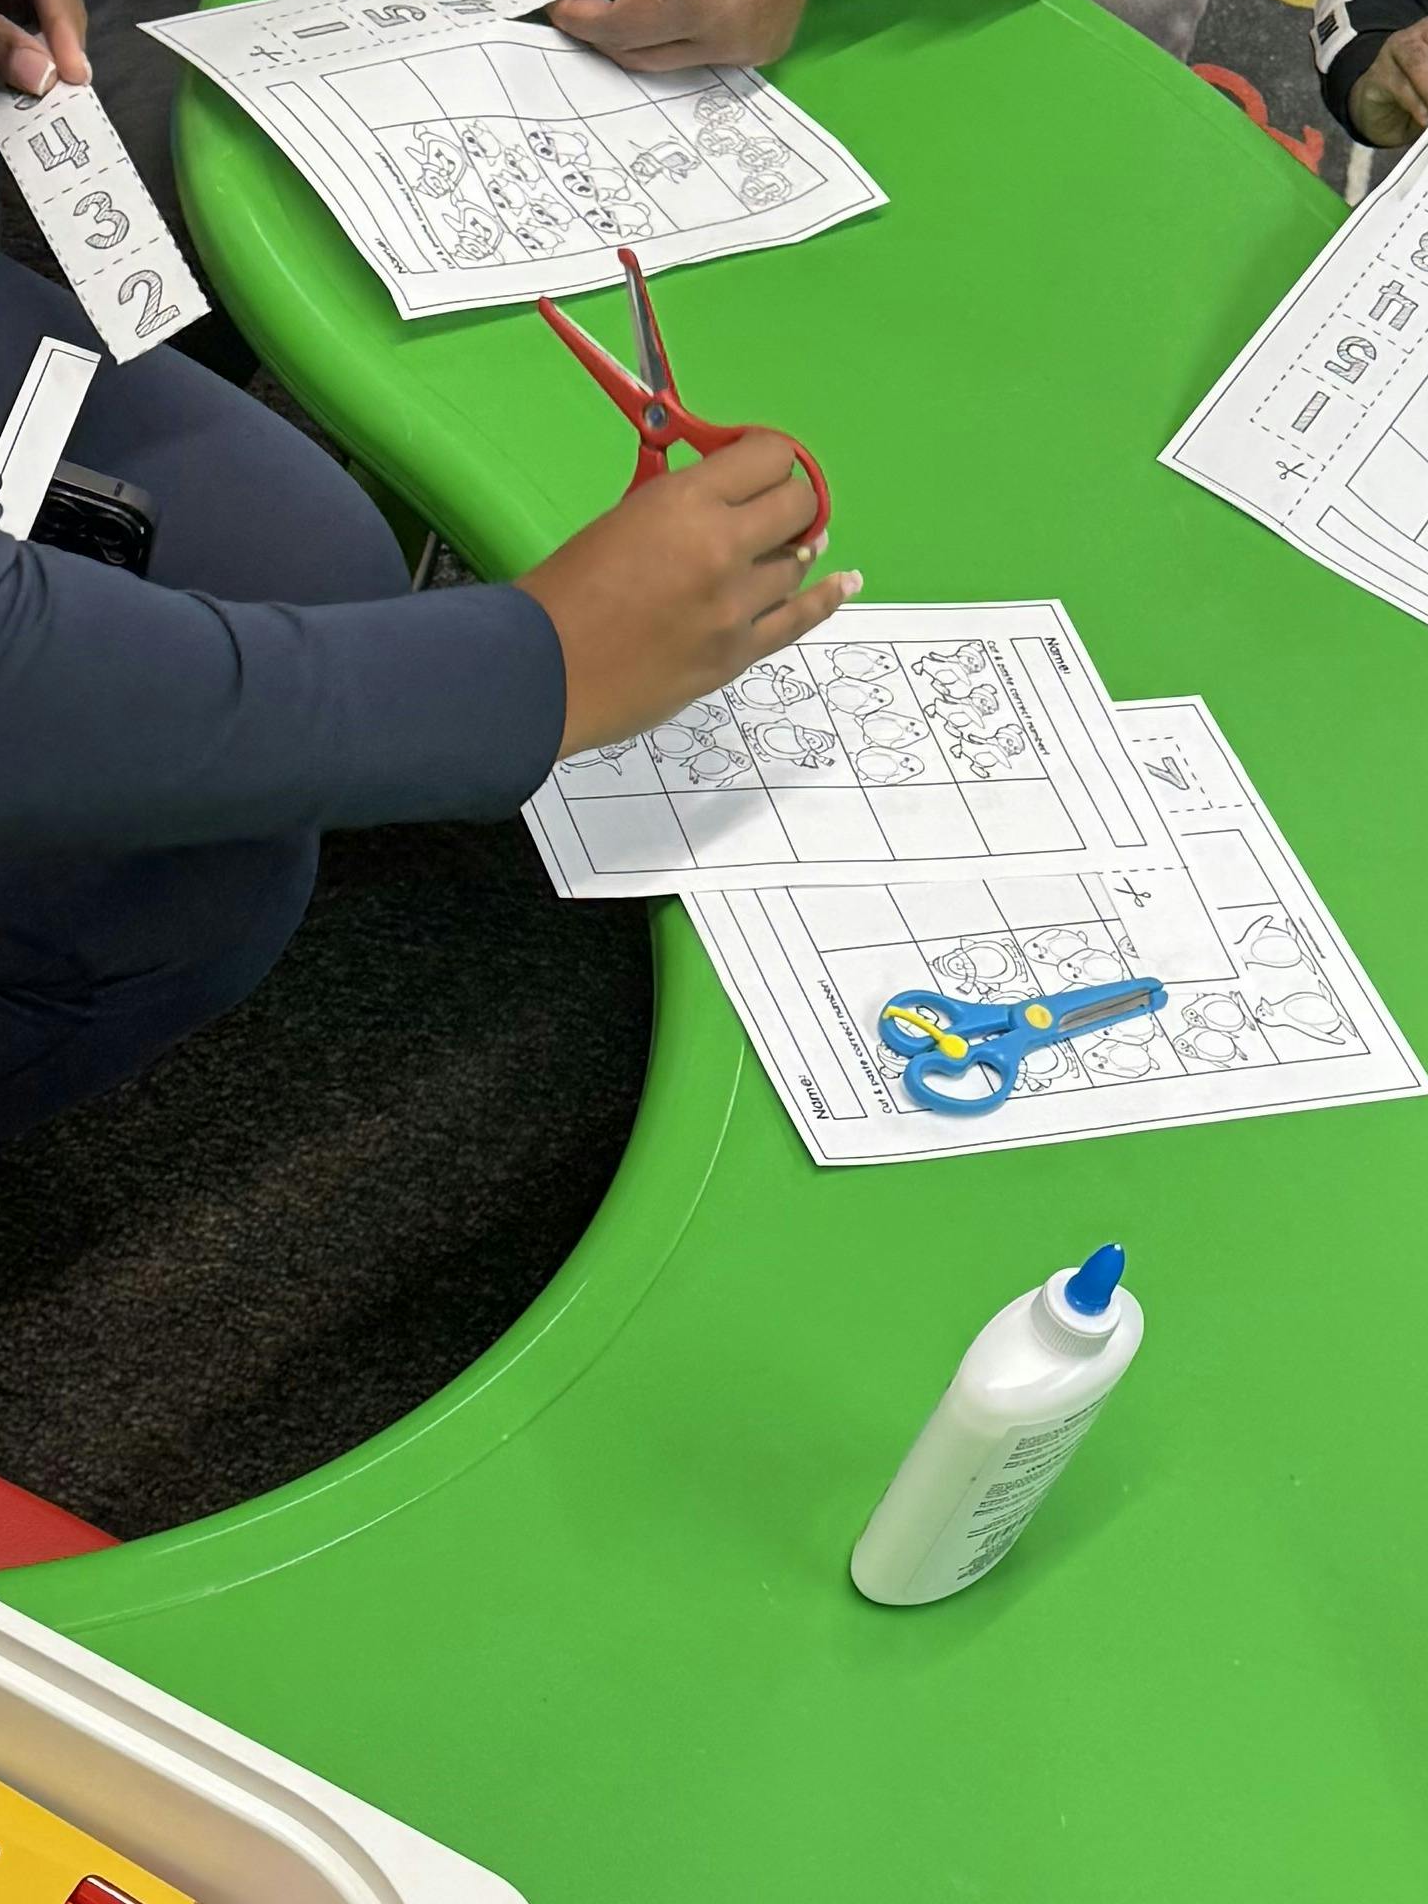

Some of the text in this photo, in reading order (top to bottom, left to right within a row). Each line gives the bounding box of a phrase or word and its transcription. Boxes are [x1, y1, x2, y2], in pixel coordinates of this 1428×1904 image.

[363, 4, 427, 28] 5
[28, 116, 90, 172] 4
[72, 190, 130, 250] 3
[118, 269, 181, 339] 2
[1368, 279, 1419, 332] 4
[1324, 335, 1377, 385] 5
[1044, 637, 1072, 675] Name:
[838, 1020, 863, 1058] correct
[798, 1074, 829, 1120] Name:
[860, 1059, 880, 1087] paste
